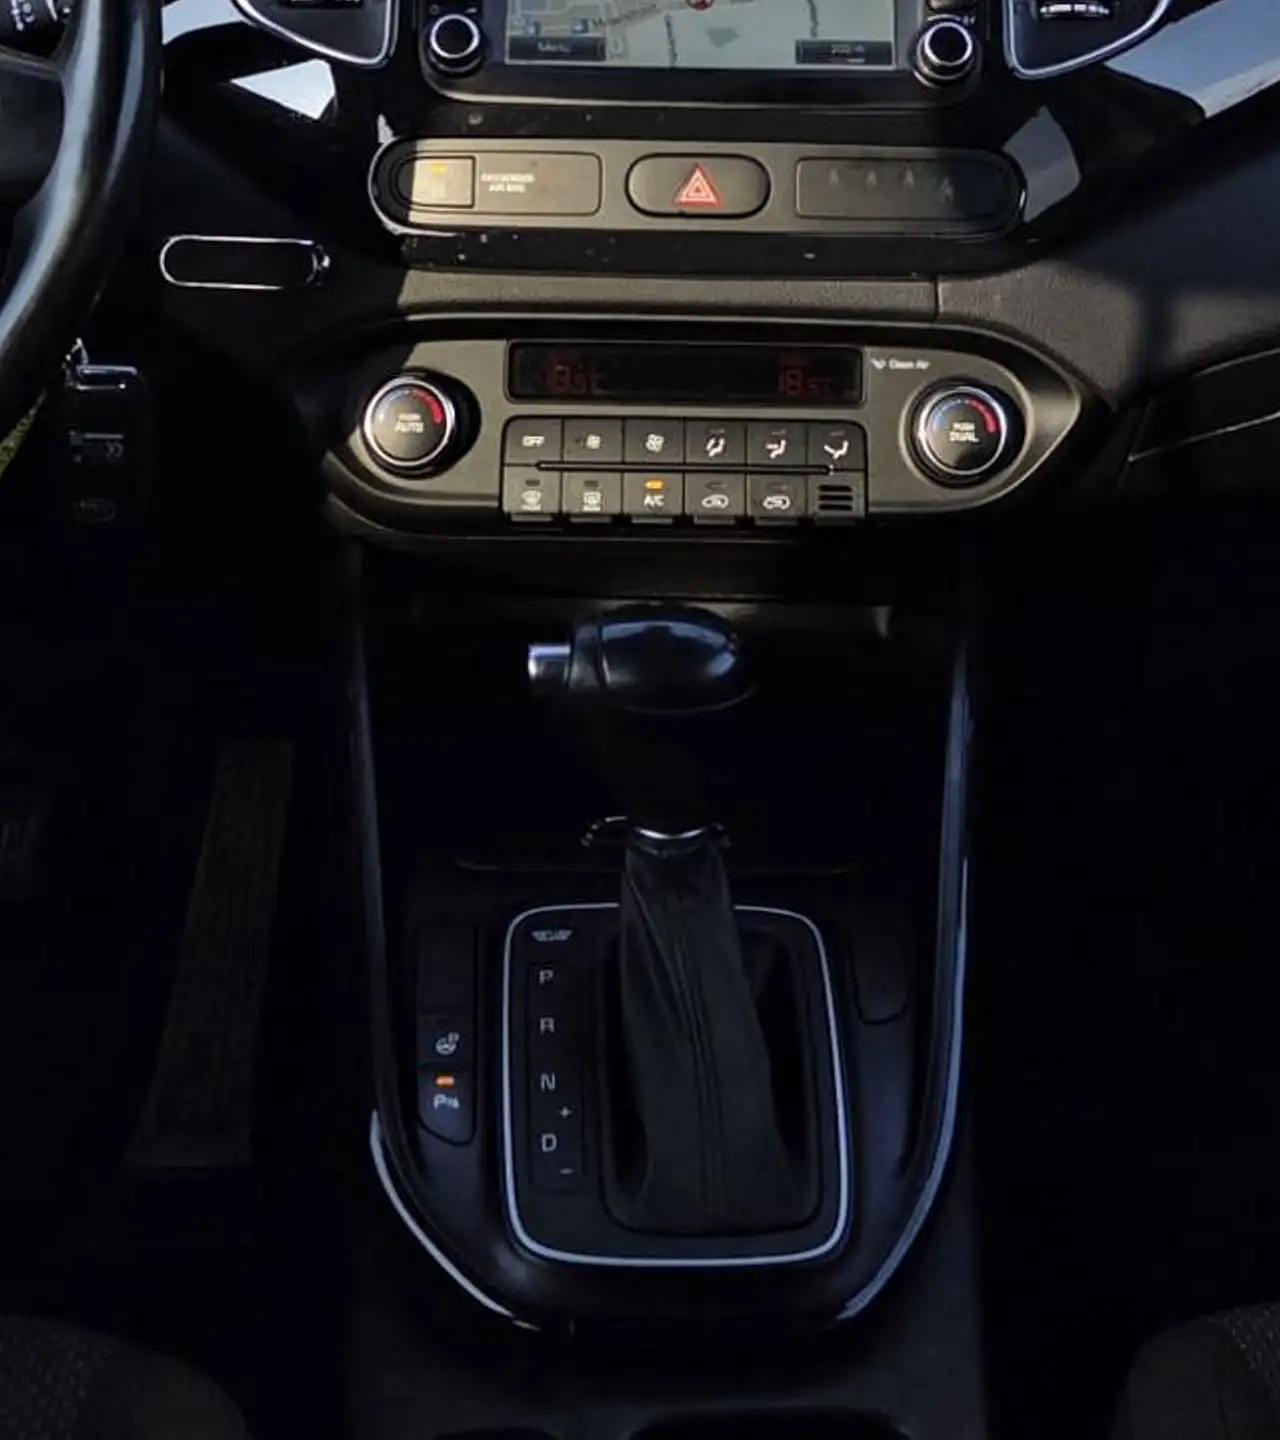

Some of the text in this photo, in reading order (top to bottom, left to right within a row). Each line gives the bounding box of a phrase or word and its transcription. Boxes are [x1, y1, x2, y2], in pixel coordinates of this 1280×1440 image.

[394, 421, 424, 434] AUTO
[522, 435, 545, 447] OFF
[539, 969, 554, 985] P
[540, 1017, 555, 1034] R
[540, 1073, 556, 1091] N
[541, 1133, 557, 1152] D
